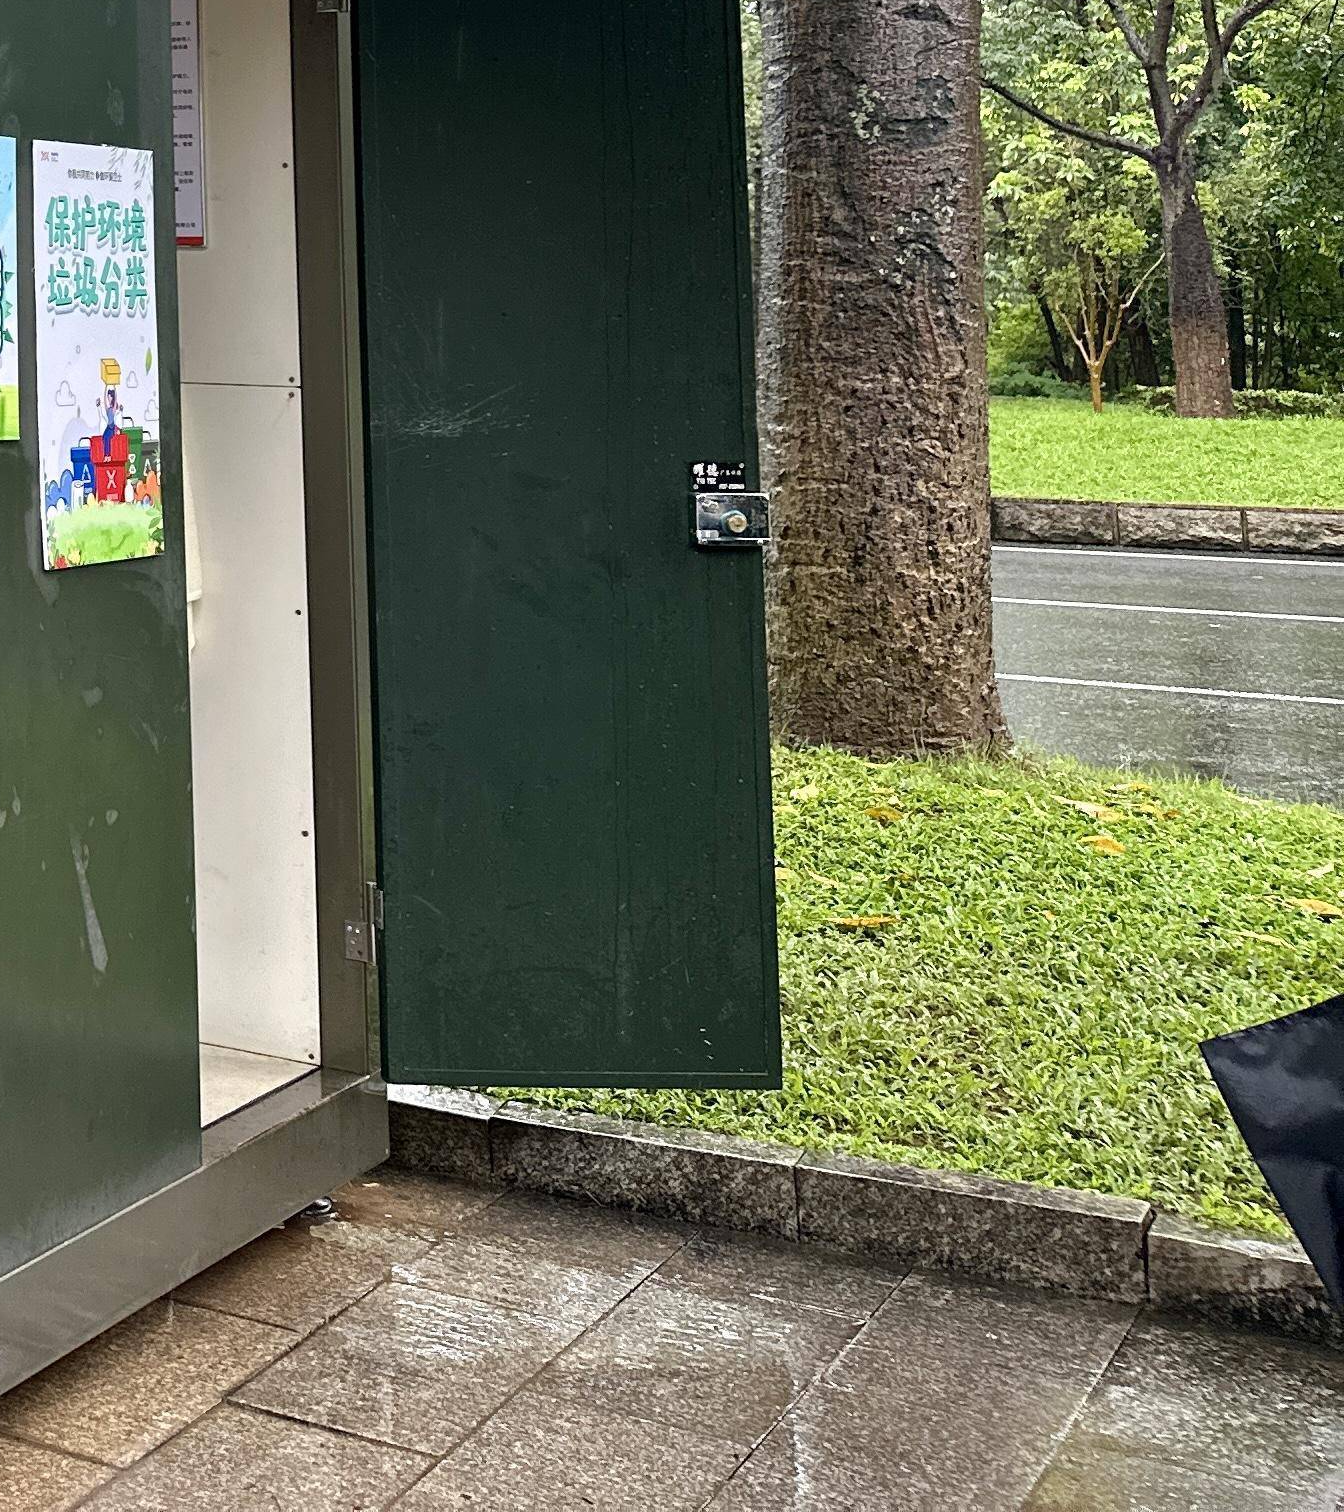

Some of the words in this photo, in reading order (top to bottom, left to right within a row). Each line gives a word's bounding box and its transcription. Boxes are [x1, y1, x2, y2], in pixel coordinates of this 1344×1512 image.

[44, 193, 148, 254] 保护环境
[47, 255, 149, 315] 垃圾分类
